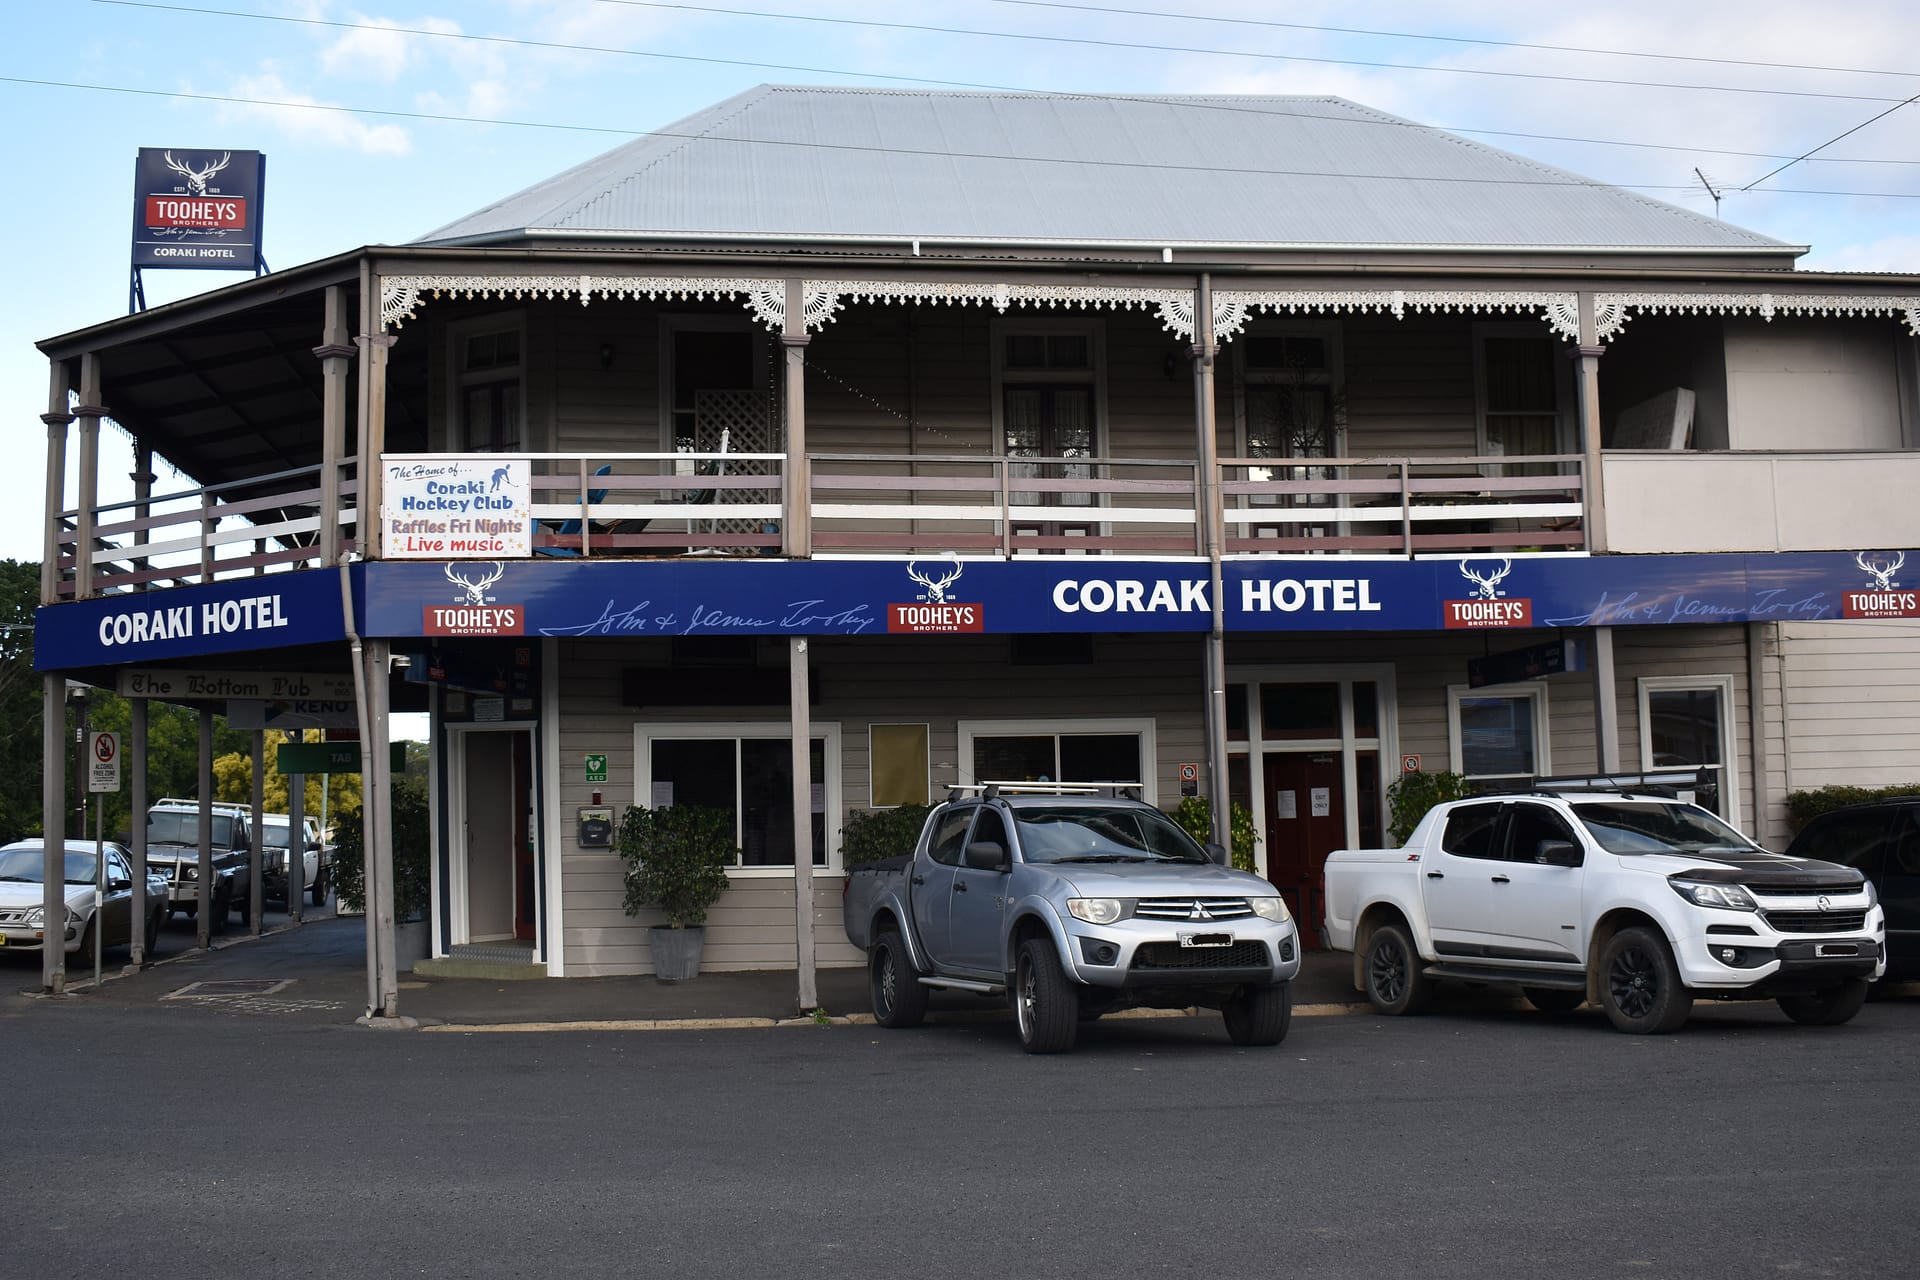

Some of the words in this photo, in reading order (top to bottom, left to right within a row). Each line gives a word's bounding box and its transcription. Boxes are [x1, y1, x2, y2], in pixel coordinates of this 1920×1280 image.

[156, 202, 236, 220] TOOHEYS
[154, 248, 196, 256] CORAKI
[200, 249, 235, 258] HOTEL
[390, 466, 410, 479] The
[413, 464, 445, 476] Home
[427, 481, 484, 494] Coraki
[402, 496, 470, 512] Hockey
[473, 496, 513, 510] Club
[392, 519, 446, 533] Raffles
[450, 519, 470, 533] Fri
[475, 519, 522, 536] Nights
[407, 536, 444, 551] Live
[450, 537, 504, 551] music
[1241, 579, 1381, 612] HOTEL
[1850, 594, 1916, 610] TOOHEYS
[434, 609, 515, 627] TOOHEYS
[897, 607, 974, 624] TOOHEYS
[1452, 602, 1523, 620] TOOHEYS
[1669, 595, 1744, 624] James
[100, 606, 193, 646] CORAKI
[202, 594, 288, 635] HOTEL
[655, 614, 677, 626] &
[679, 605, 775, 635] James
[132, 674, 171, 694] The
[186, 675, 258, 696] Bottom
[272, 677, 311, 696] Pub
[294, 701, 349, 713] KENO
[330, 753, 352, 763] TAB
